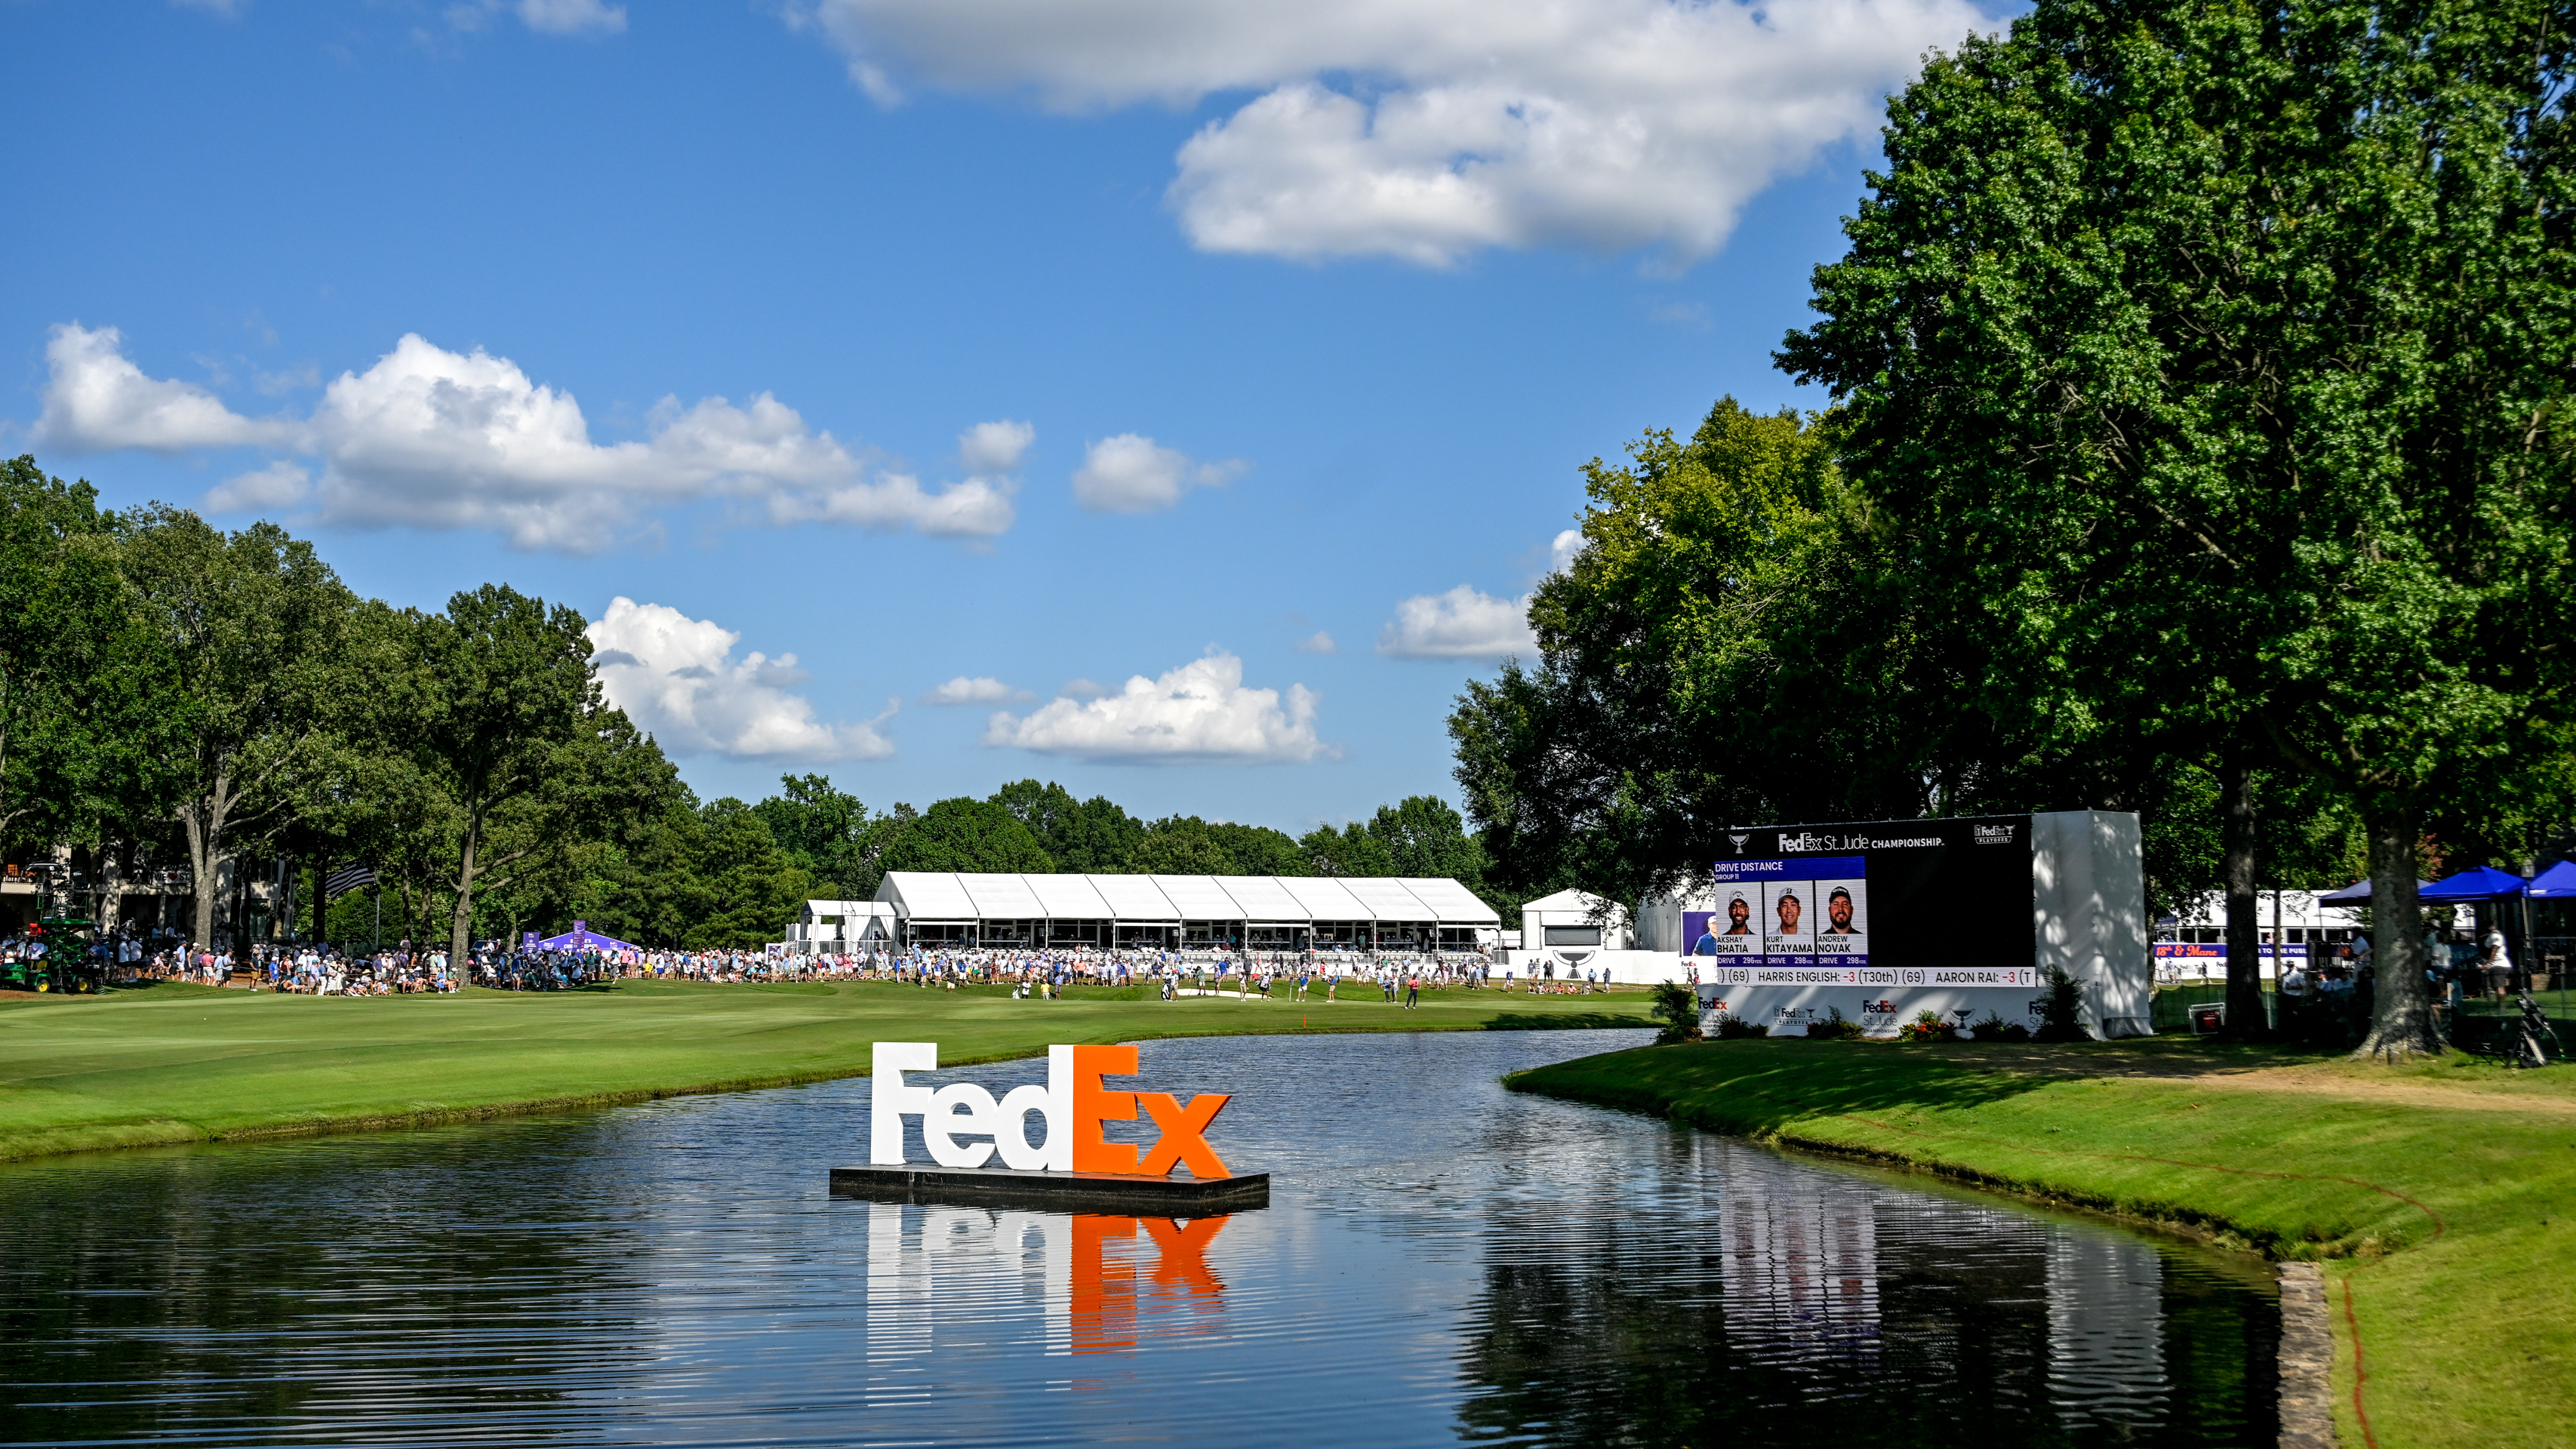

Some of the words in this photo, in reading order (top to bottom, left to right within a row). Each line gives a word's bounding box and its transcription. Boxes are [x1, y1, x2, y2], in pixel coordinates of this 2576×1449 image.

[1981, 826, 2005, 836] FedEx
[1778, 832, 1823, 852] FedEx
[1840, 834, 1869, 851] Jude
[1871, 838, 1942, 849] CHAMPIONSHIP
[1715, 863, 1739, 872] DRIVE
[1740, 861, 1783, 872] DISTANCE
[1717, 944, 1748, 953] BHATIA
[1766, 943, 1813, 953] KITAYAMA
[1818, 943, 1851, 952] NOVAK
[2156, 946, 2172, 956] 18th
[2174, 945, 2184, 956] &
[2186, 945, 2217, 957] Mane
[1728, 968, 1750, 983] (69)
[1759, 971, 1793, 982] HARRIS
[1796, 971, 1840, 982] ENGLISH:
[1843, 971, 1855, 982] -3
[1858, 968, 1897, 985] (T30th)
[1902, 968, 1925, 985] (69)
[1936, 972, 1974, 983] AARON
[1978, 972, 1999, 983] RAI:
[2002, 971, 2015, 983] -3
[1698, 996, 1728, 1010] FedEx
[1863, 1000, 1897, 1014] FedEx
[1781, 1008, 1805, 1018] FedEx
[1875, 1015, 1897, 1026] Jude
[870, 1042, 1233, 1179] FedEx
